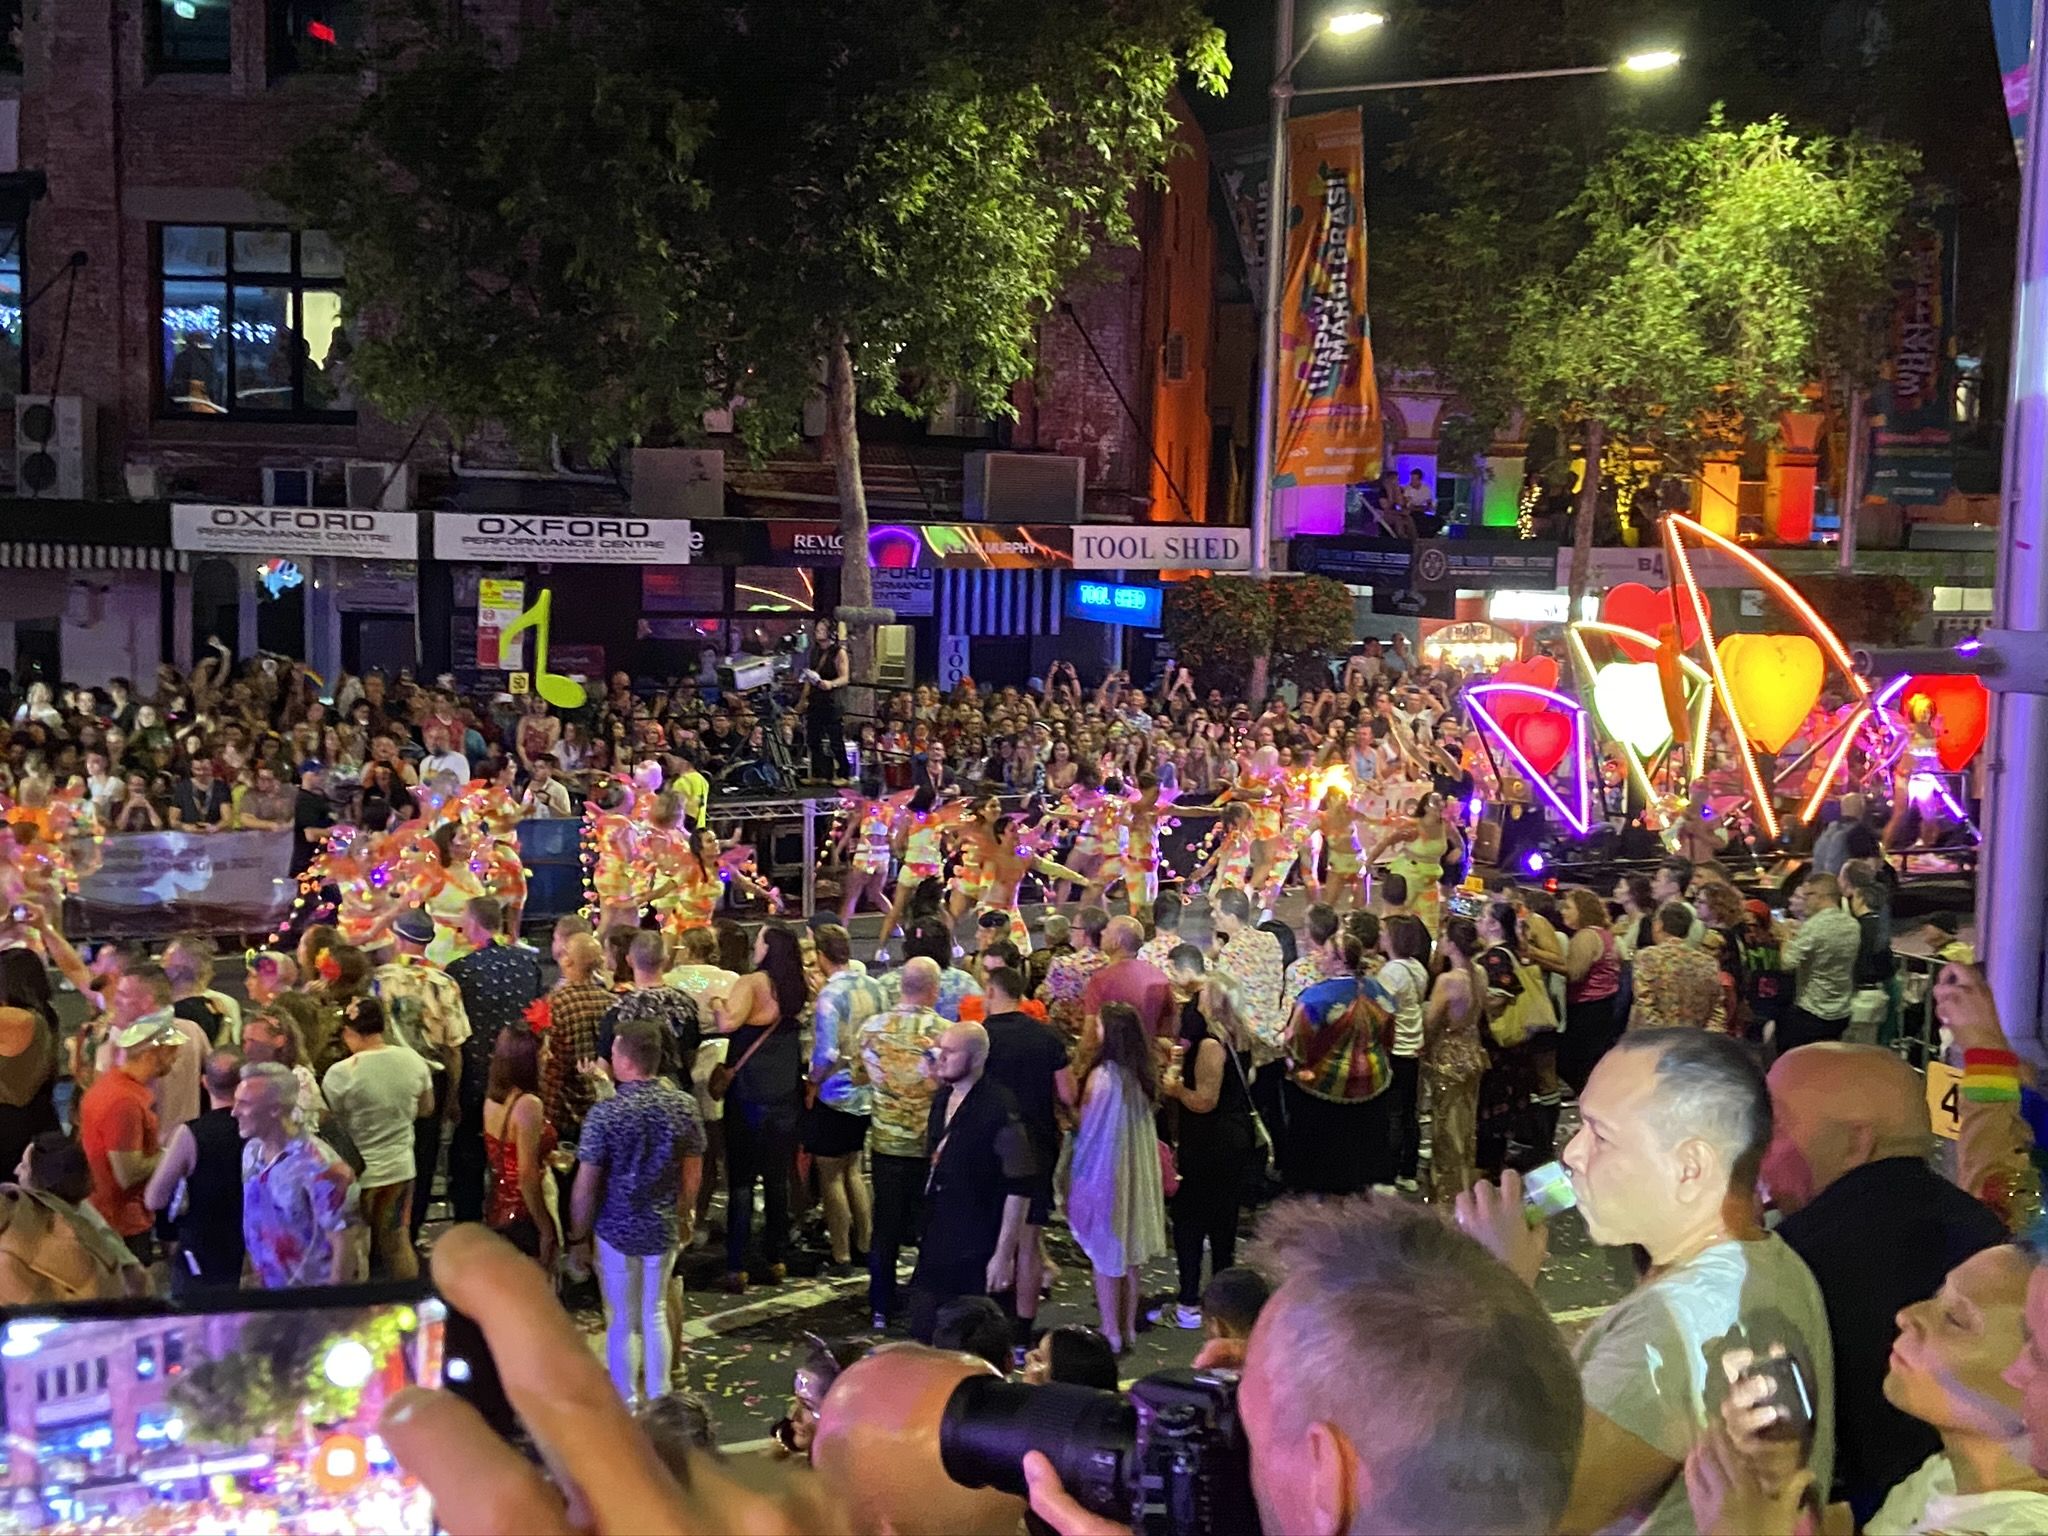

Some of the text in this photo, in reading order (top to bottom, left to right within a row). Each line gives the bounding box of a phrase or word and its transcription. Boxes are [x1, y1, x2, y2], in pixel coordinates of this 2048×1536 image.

[1328, 270, 1350, 361] MARDI
[1309, 296, 1333, 391] HAPPY
[211, 508, 375, 531] OXFORD
[478, 518, 650, 538] OXFORD
[197, 527, 392, 543] PERFORMANCE CENTRE
[462, 536, 665, 549] PERFORMANCE CENTRE
[1080, 536, 1240, 560] TOOL SHED
[1080, 584, 1146, 609] TOOL SHED
